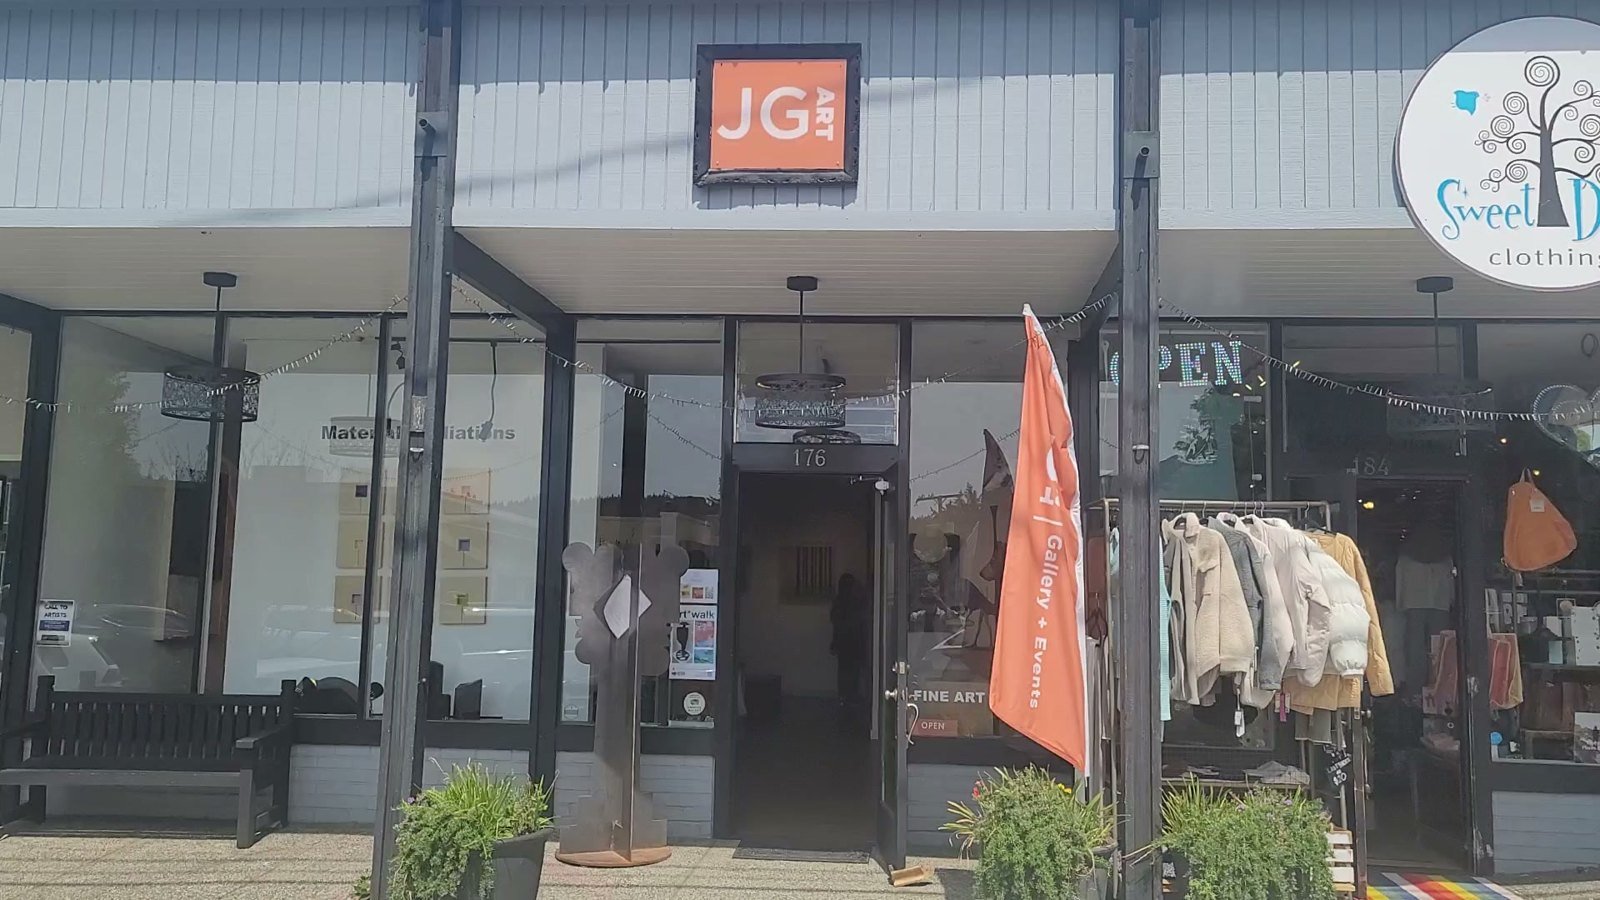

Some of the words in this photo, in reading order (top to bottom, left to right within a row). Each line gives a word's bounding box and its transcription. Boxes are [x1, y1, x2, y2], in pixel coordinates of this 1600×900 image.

[716, 86, 810, 140] JG
[815, 86, 836, 142] ART
[1437, 179, 1536, 240] Sweet
[1489, 248, 1600, 269] clothin
[793, 448, 826, 467] 176
[1353, 456, 1389, 476] 184
[1036, 534, 1063, 610] Gallery
[1029, 636, 1047, 709] Events
[913, 689, 950, 702] FINE
[953, 691, 986, 704] ART
[921, 721, 946, 731] OPEN
